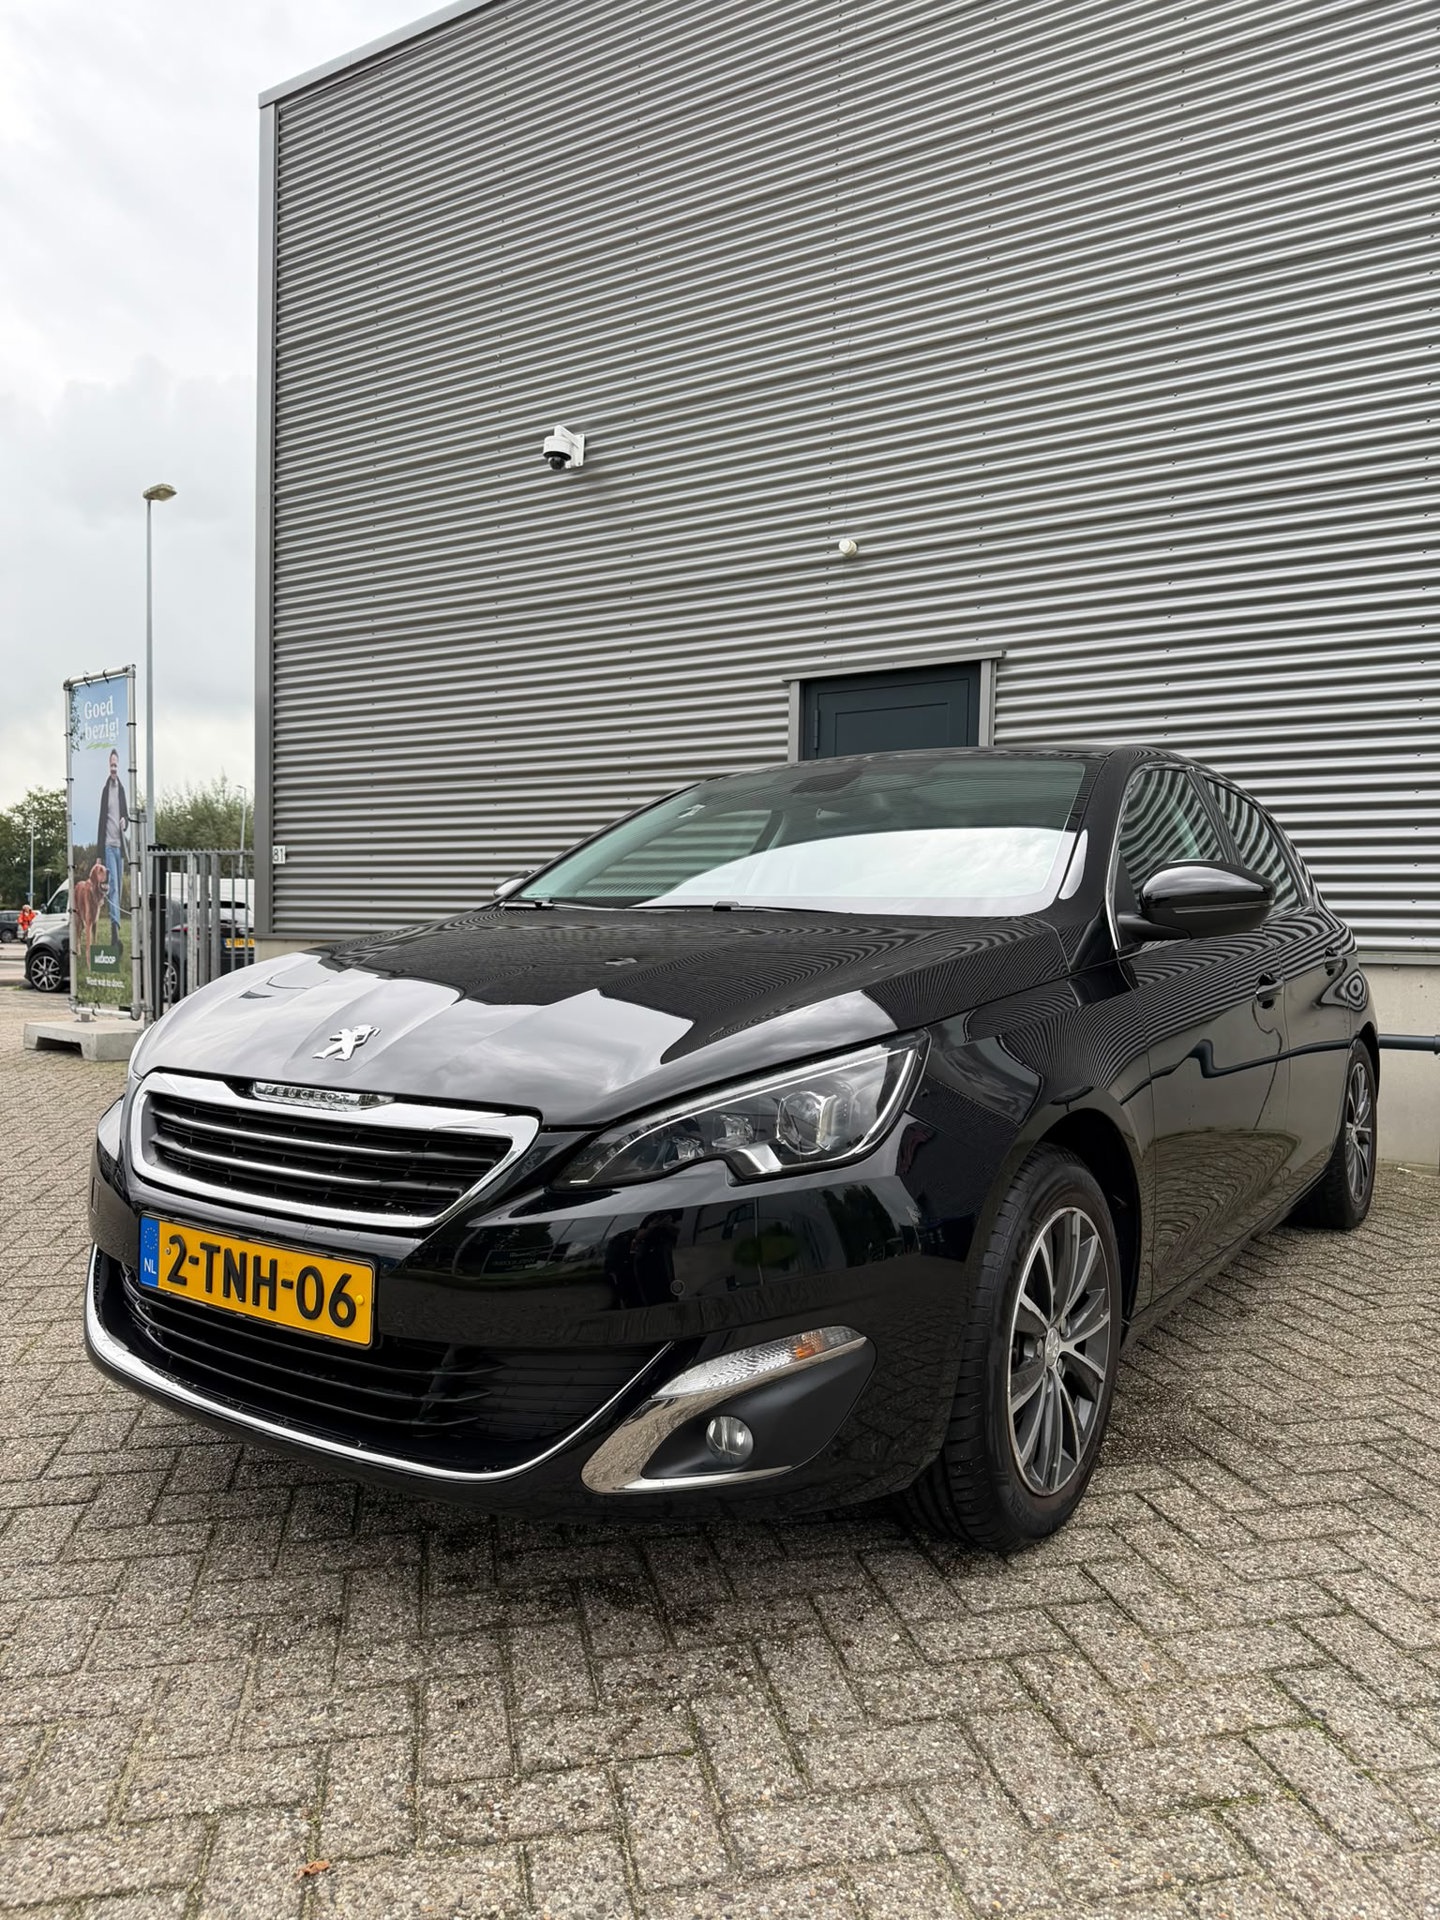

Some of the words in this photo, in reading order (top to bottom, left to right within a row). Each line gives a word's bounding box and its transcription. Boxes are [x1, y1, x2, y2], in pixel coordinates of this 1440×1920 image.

[84, 695, 114, 719] Goed
[84, 717, 119, 741] bezig!
[273, 848, 284, 862] 81
[264, 1084, 350, 1102] PEUGEOT
[143, 1257, 157, 1275] NL
[167, 1234, 357, 1328] 2-TNH-06
